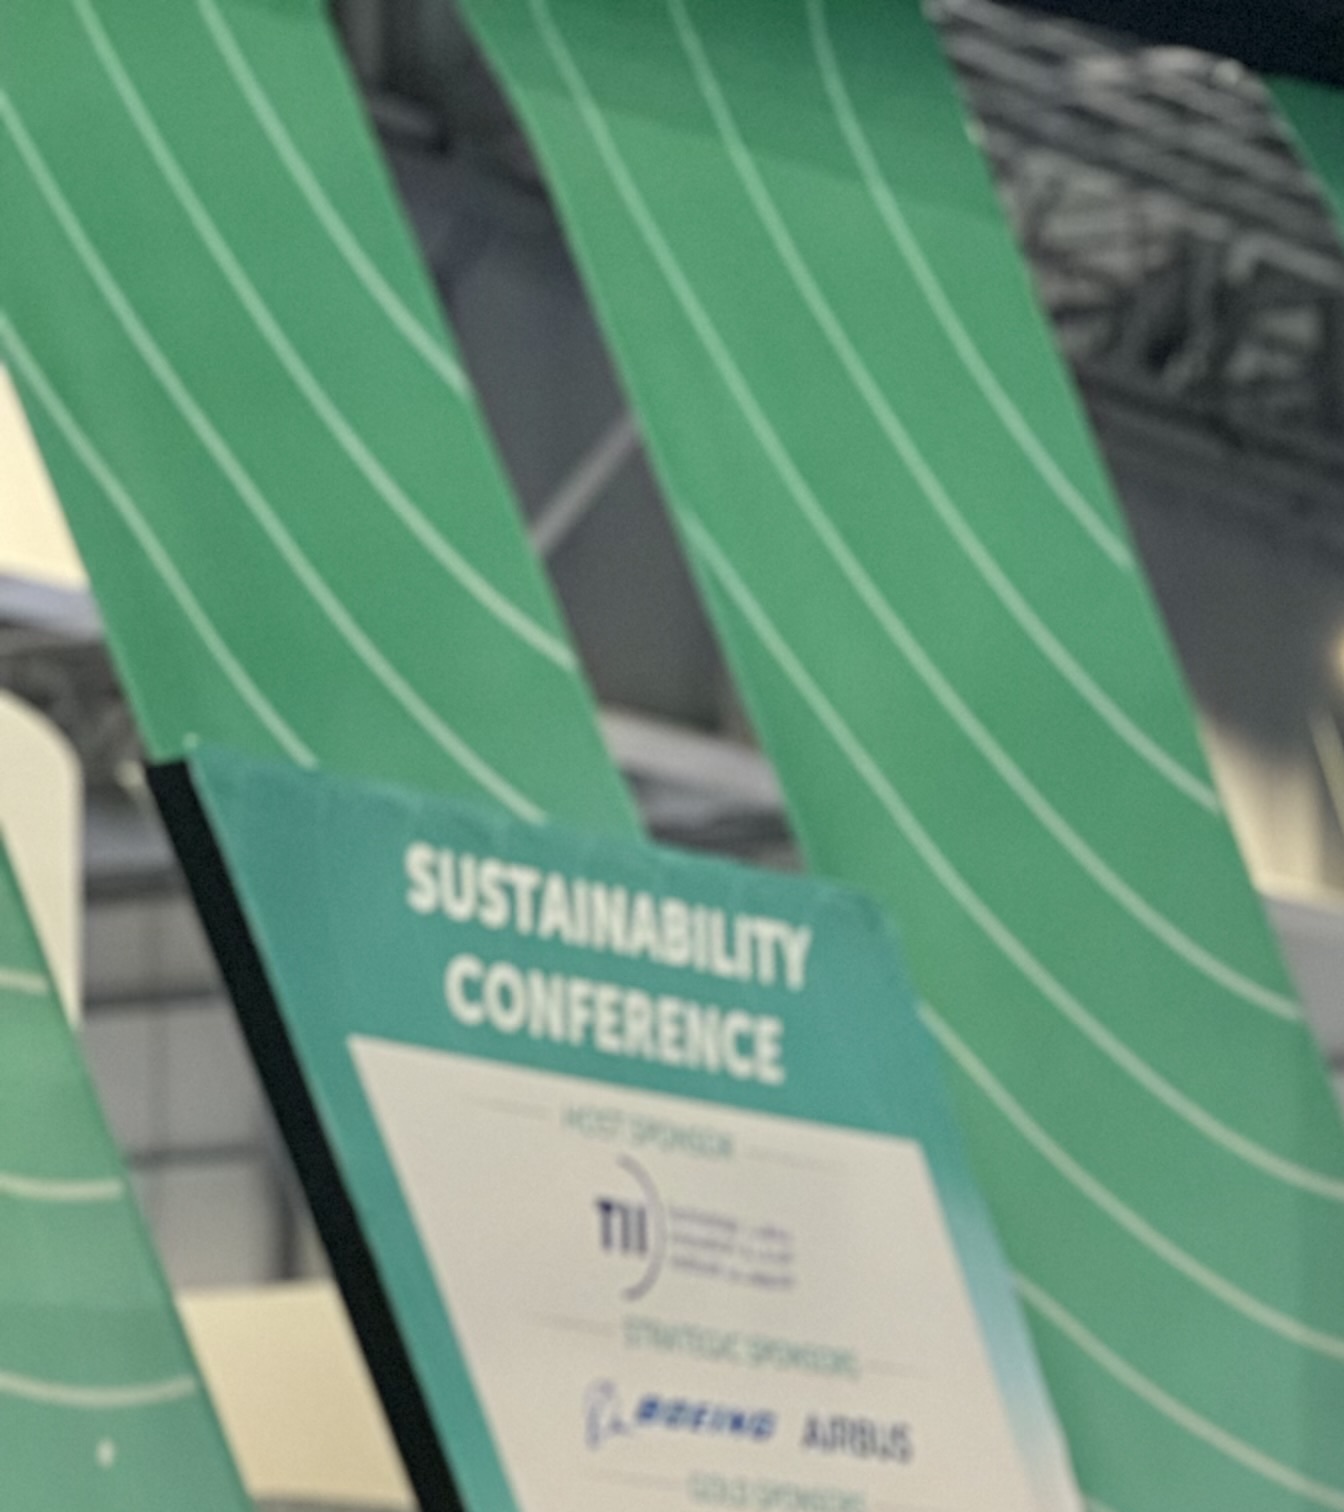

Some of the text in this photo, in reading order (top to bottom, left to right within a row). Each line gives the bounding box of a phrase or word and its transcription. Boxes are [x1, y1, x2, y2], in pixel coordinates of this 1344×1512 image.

[404, 840, 812, 991] SUSTAINABILITY
[444, 953, 785, 1086] CONFERENCE
[800, 1410, 914, 1463] AIRBUS
